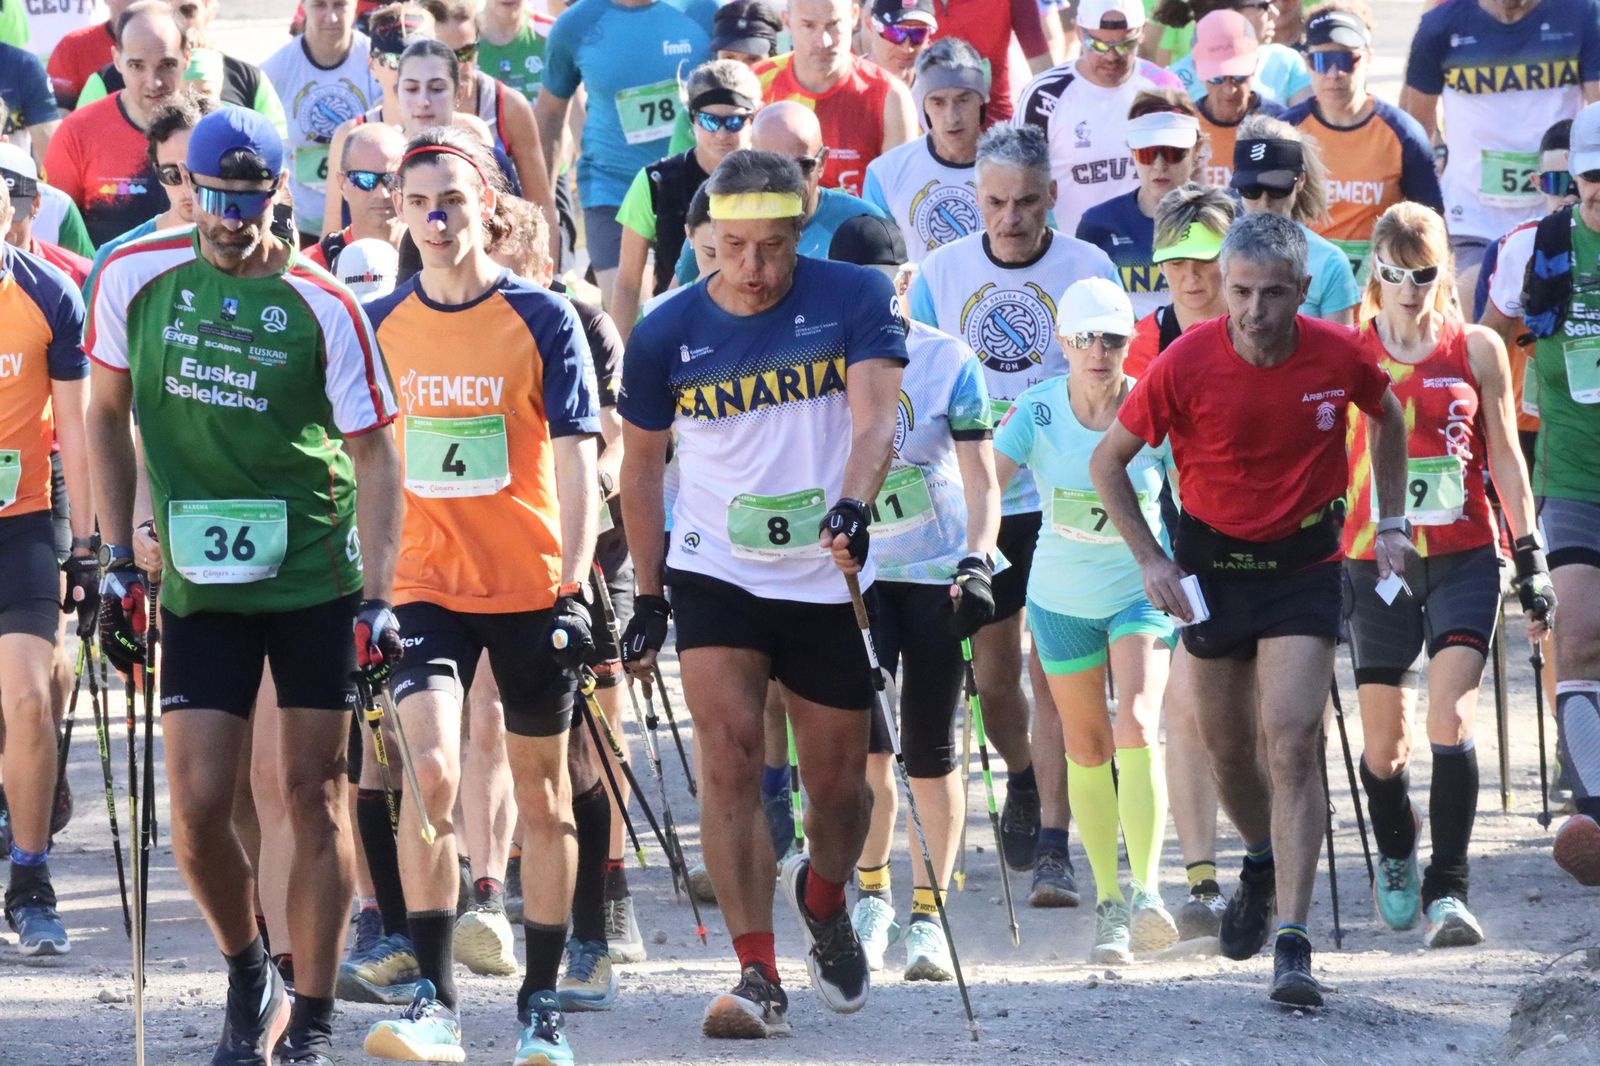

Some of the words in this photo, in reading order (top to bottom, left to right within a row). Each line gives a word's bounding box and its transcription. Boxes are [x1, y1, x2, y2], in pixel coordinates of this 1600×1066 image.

[640, 98, 676, 126] 78
[1326, 180, 1384, 205] EMECV
[1502, 169, 1538, 193] 52
[1020, 294, 1029, 304] DE
[204, 340, 242, 354] SCARPA
[249, 346, 288, 360] EUSKADI
[180, 357, 258, 390] Euskal
[1000, 363, 1019, 371] FGM
[164, 376, 269, 412] Selekzioa
[417, 376, 504, 407] FEMECV
[442, 443, 467, 476] 4
[1408, 479, 1428, 508] 9
[767, 516, 791, 545] 8
[1091, 507, 1109, 532] 7
[204, 526, 255, 561] 36
[115, 630, 138, 651] LEKI
[376, 732, 386, 763] GABEL
